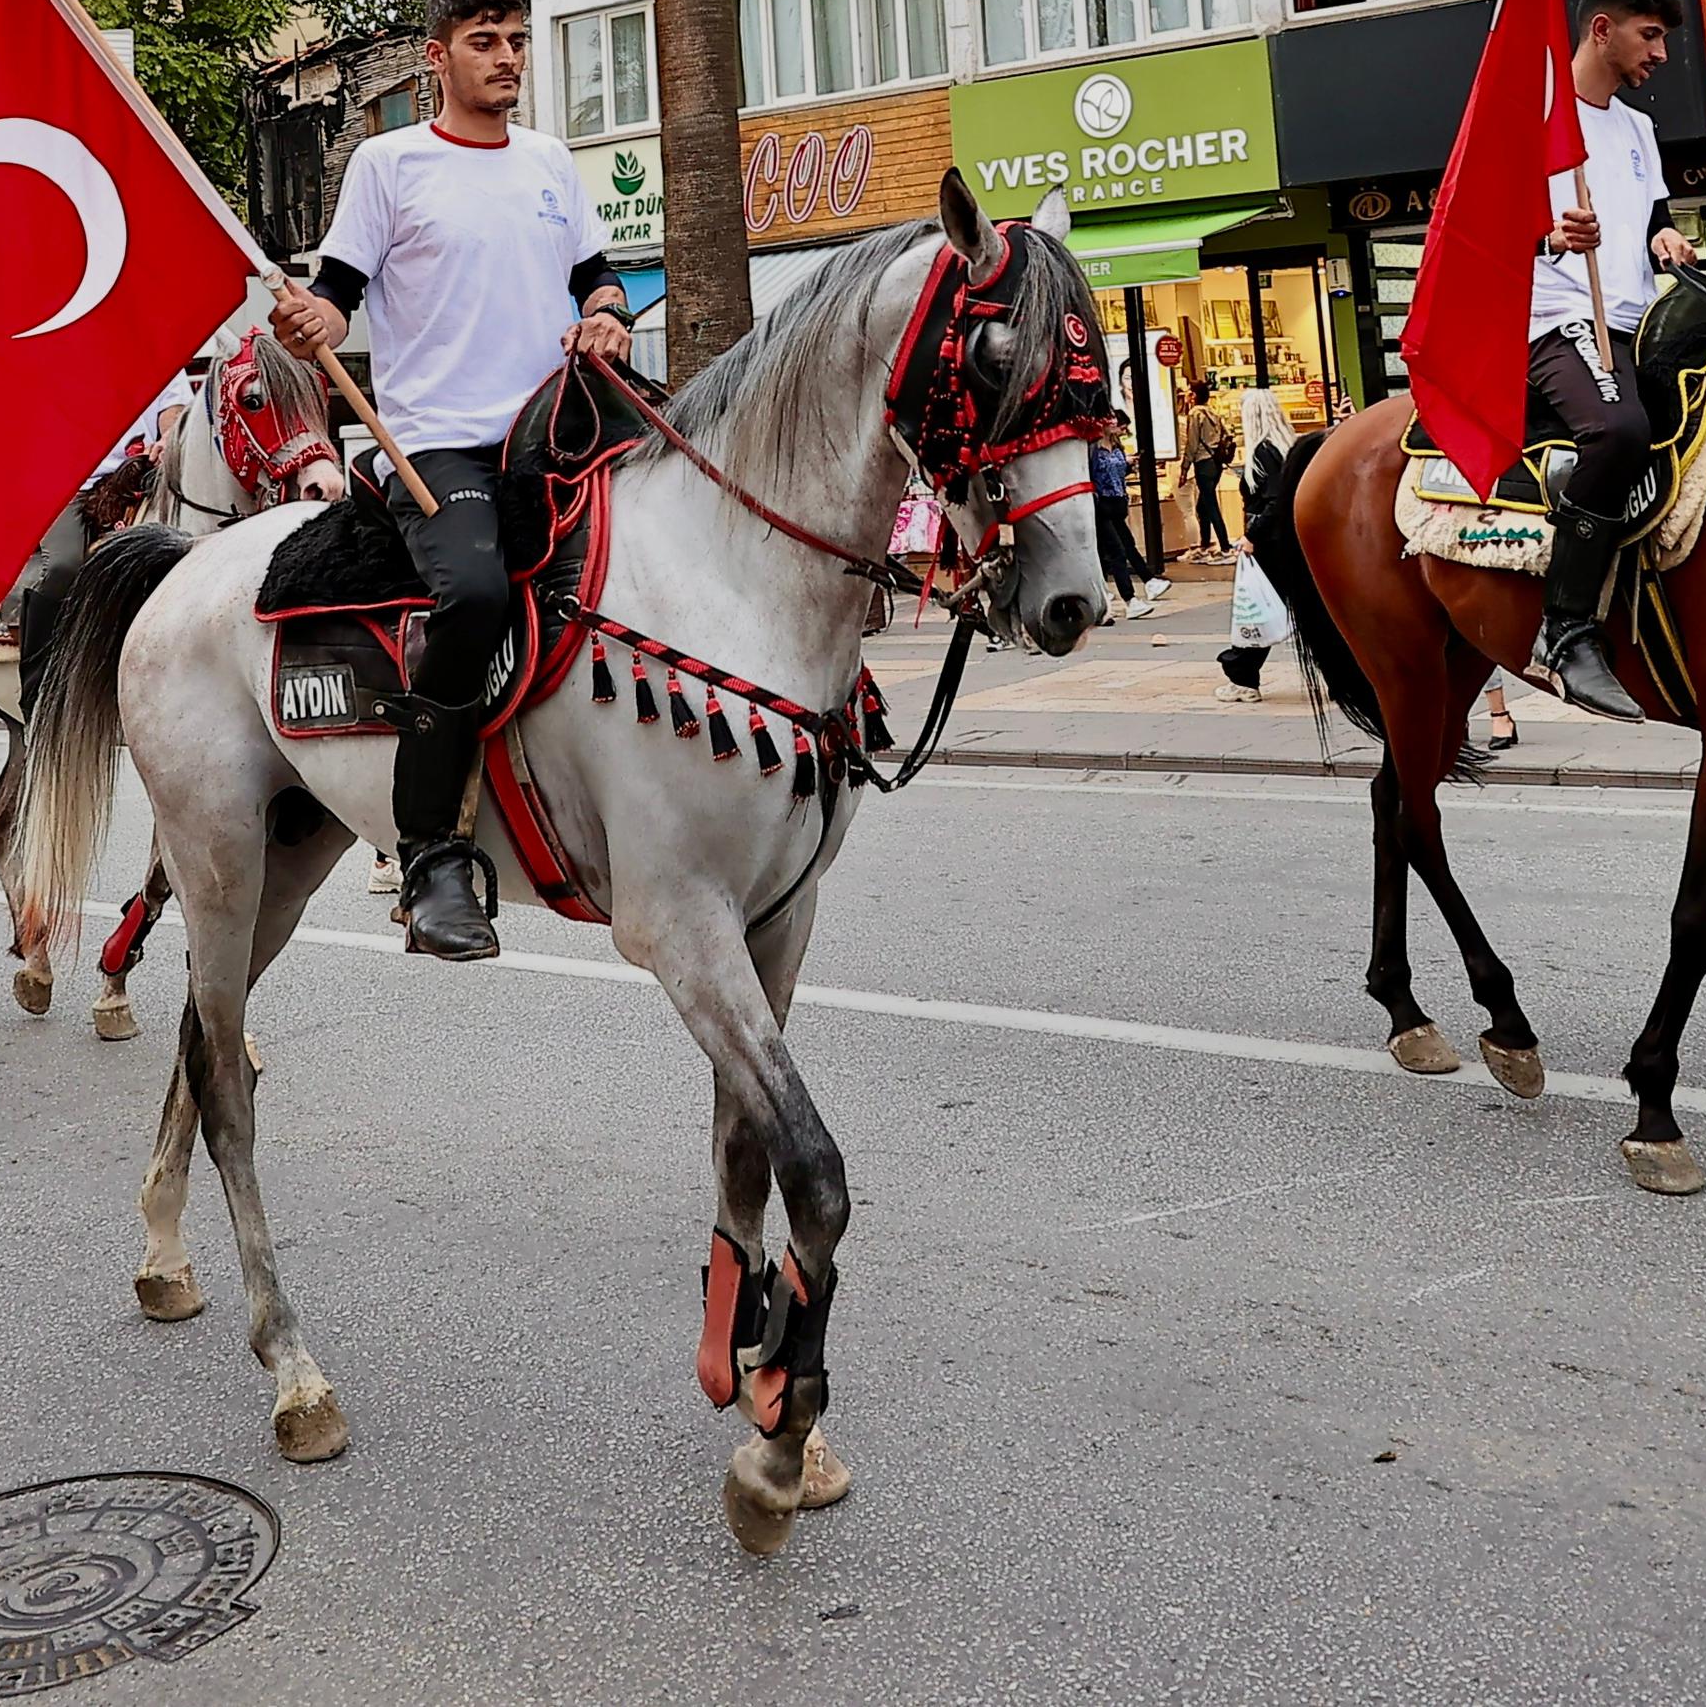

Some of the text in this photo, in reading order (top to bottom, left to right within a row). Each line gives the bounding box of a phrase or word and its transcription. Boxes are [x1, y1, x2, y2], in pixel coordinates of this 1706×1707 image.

[976, 127, 1249, 191] YVES ROCHER
[1061, 177, 1164, 203] RANCE
[612, 223, 651, 243] AKTAR
[282, 673, 348, 721] AYDIN
